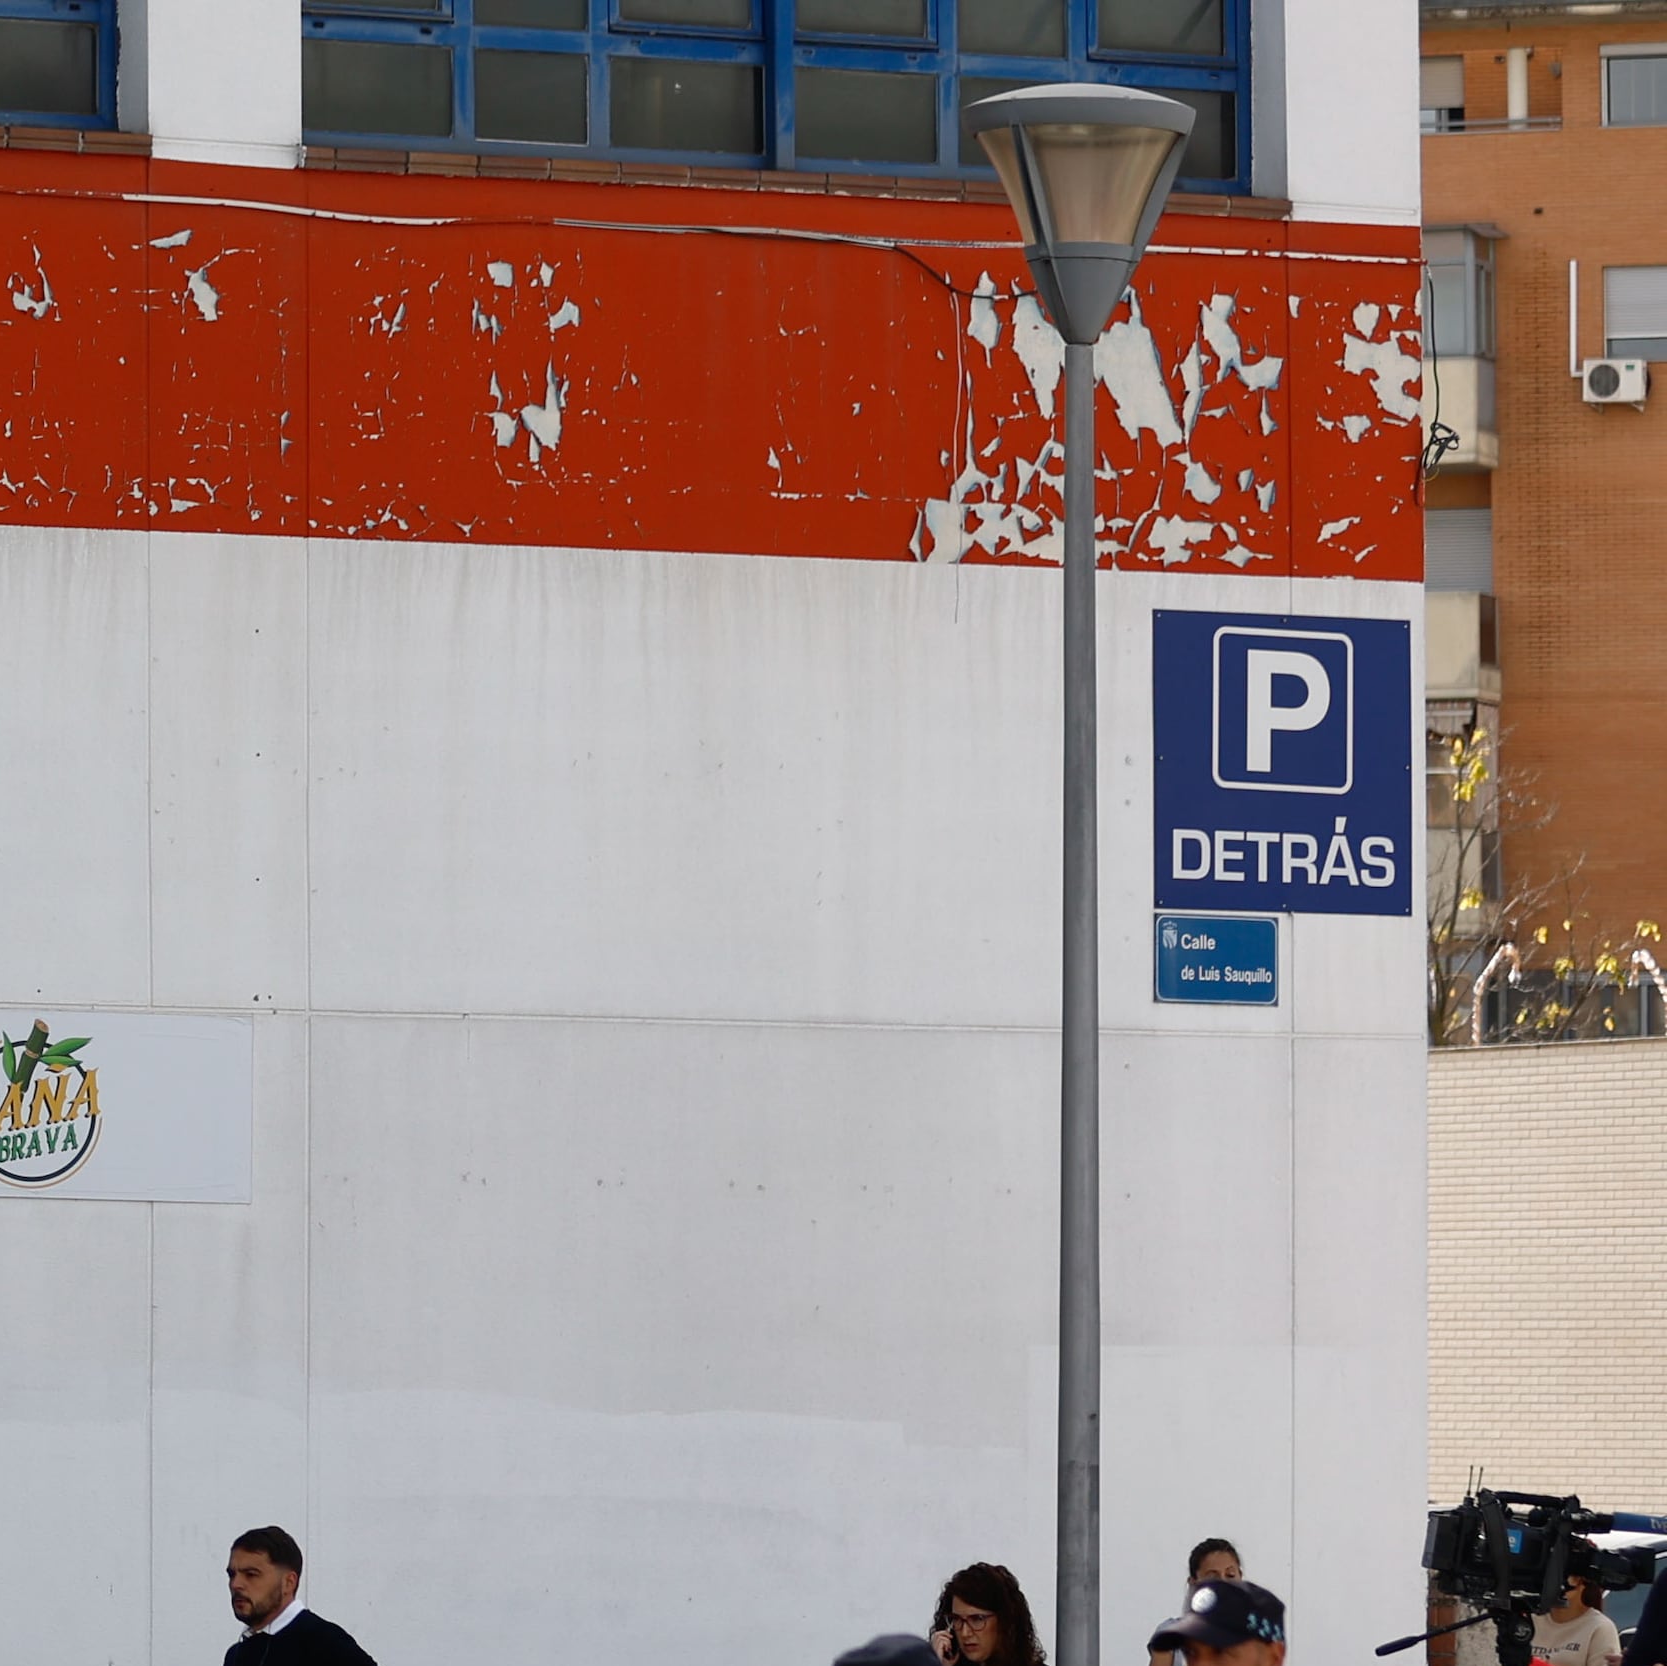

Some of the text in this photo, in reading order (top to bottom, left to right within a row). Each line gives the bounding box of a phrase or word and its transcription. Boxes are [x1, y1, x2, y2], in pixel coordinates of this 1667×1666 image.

[1246, 648, 1331, 773] P
[1172, 815, 1396, 888] DETRÁS
[1180, 933, 1216, 950] Calle
[1180, 964, 1272, 986] de Luis Sauquillo
